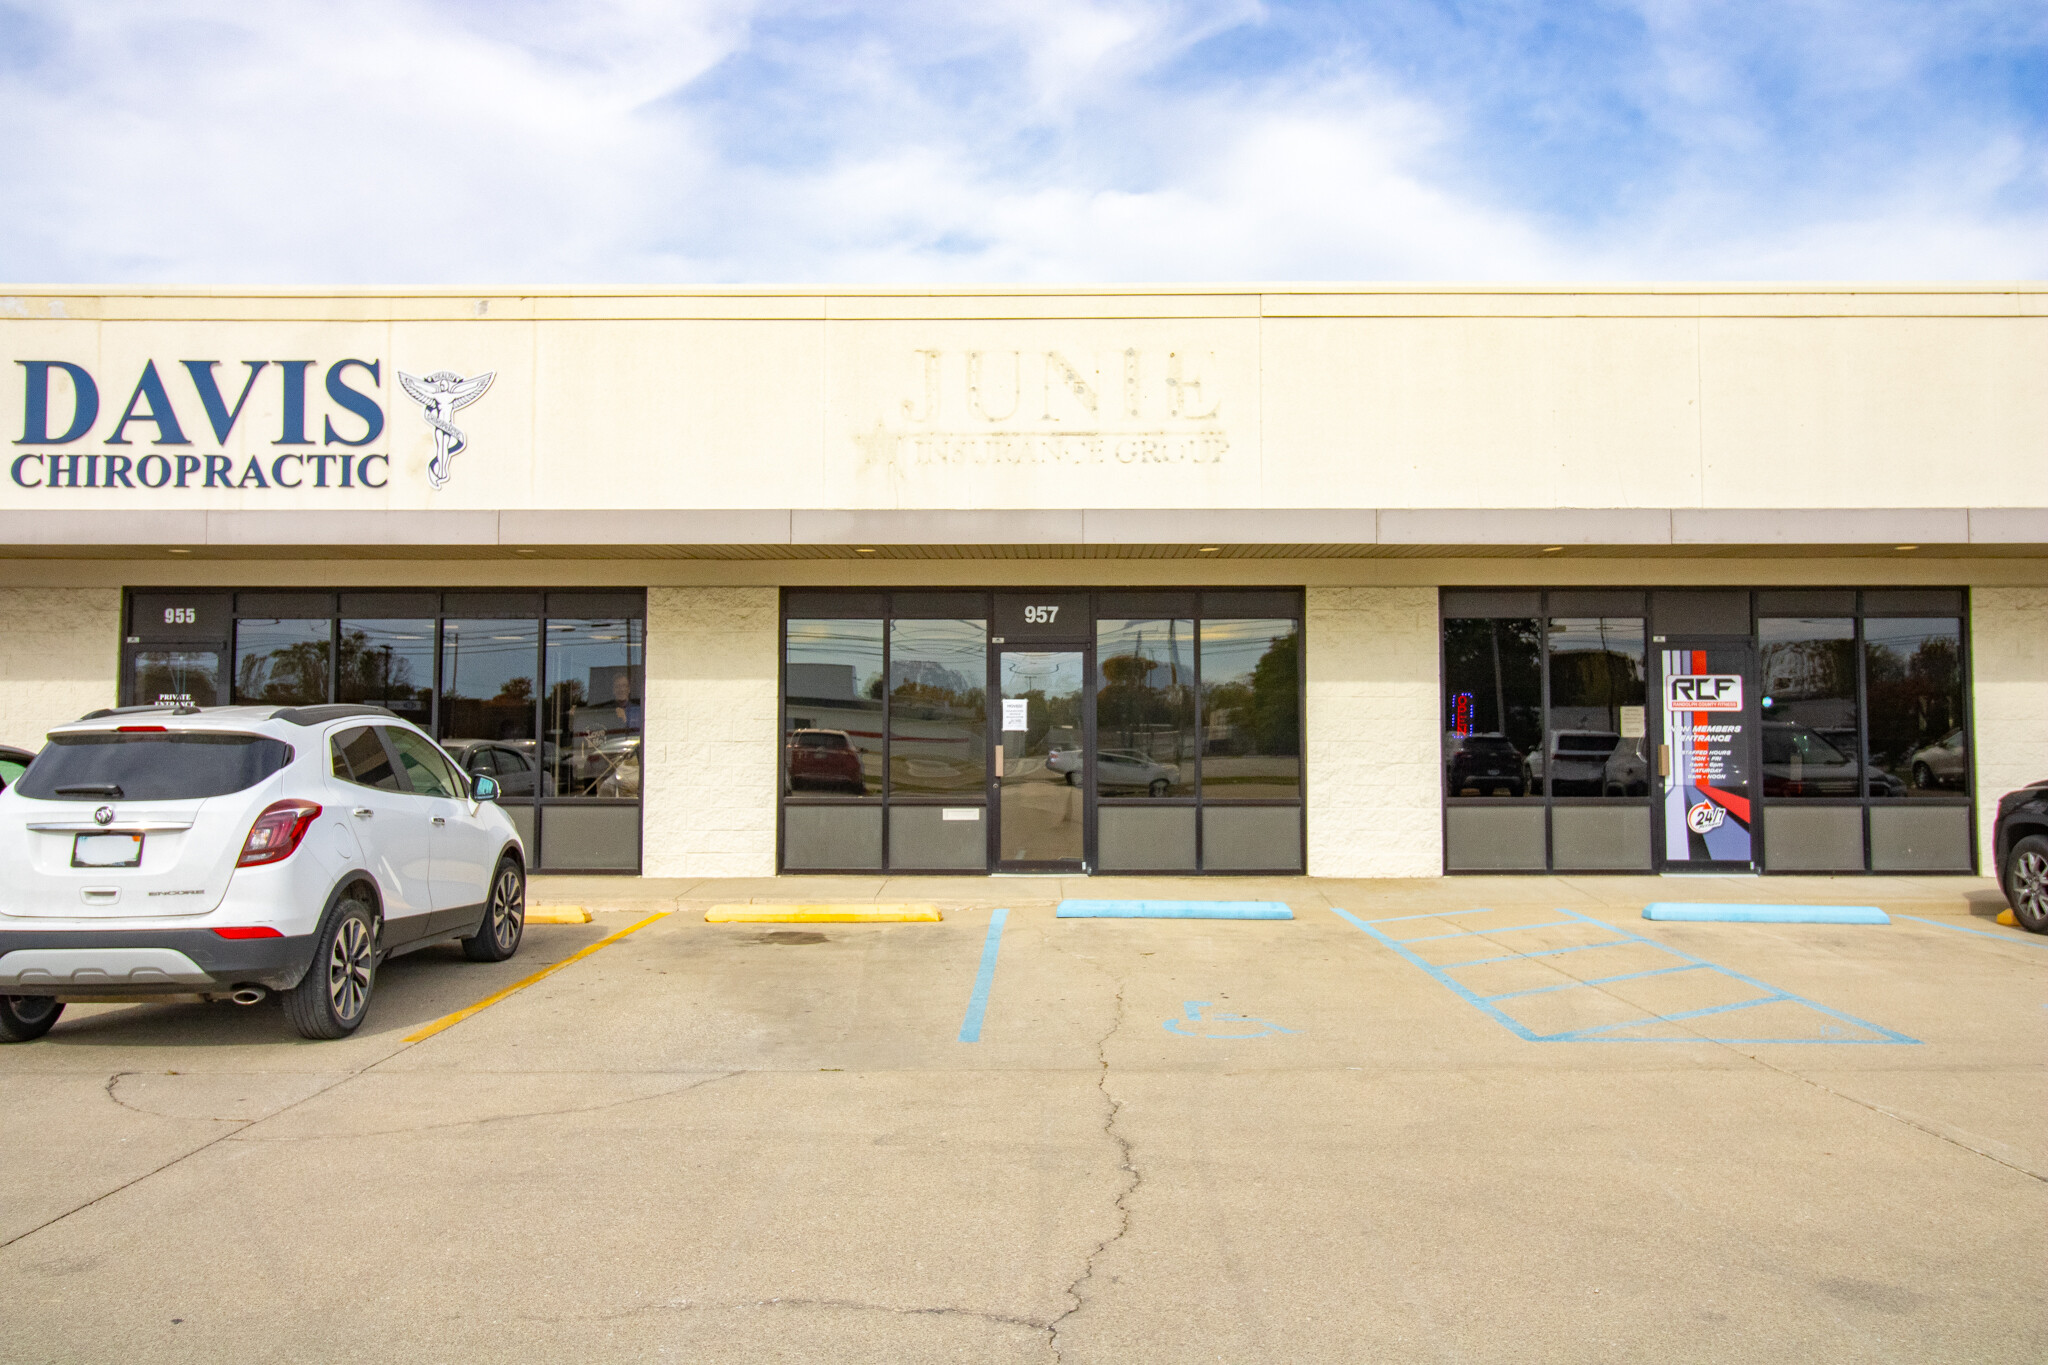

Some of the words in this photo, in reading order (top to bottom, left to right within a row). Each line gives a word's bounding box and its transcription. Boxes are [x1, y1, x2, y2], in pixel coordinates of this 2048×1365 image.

[901, 349, 1222, 422] JUNIE
[12, 358, 385, 447] DAVIS
[1114, 440, 1231, 465] GROUP
[11, 453, 389, 489] CHIROPRACTIC
[164, 608, 195, 624] 955
[1024, 605, 1059, 624] 957
[1671, 678, 1736, 700] RCF
[1457, 695, 1468, 736] OPEN
[1680, 734, 1732, 742] ENTRANCE
[1692, 725, 1743, 733] MEMBERS
[1695, 808, 1725, 826] 24/7
[148, 889, 205, 897] ENCORE
